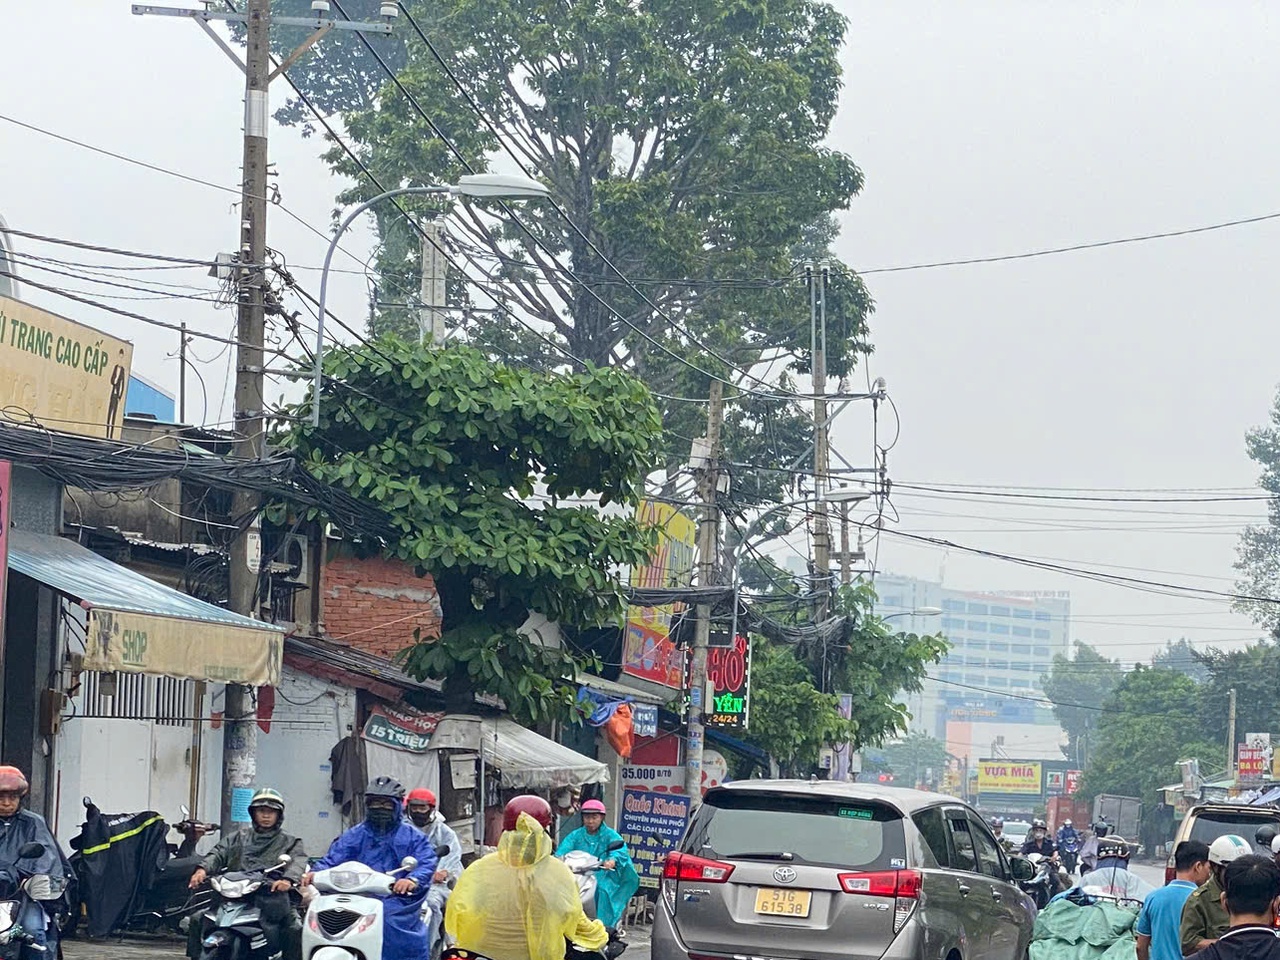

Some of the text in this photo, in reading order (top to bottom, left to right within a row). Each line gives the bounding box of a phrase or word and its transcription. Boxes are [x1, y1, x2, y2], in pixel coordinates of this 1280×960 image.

[11, 319, 53, 360] TRANG
[56, 336, 80, 369] CAO
[83, 340, 108, 376] CẤP
[122, 630, 147, 663] SHOP
[688, 635, 747, 693] HỞ
[713, 714, 738, 723] 24/24
[370, 724, 387, 737] 15
[387, 729, 430, 750] TRIỆU
[622, 768, 655, 779] 35.000
[625, 794, 687, 818] Quốc Khánh
[761, 901, 802, 915] 615.38
[773, 890, 795, 902] 51G
